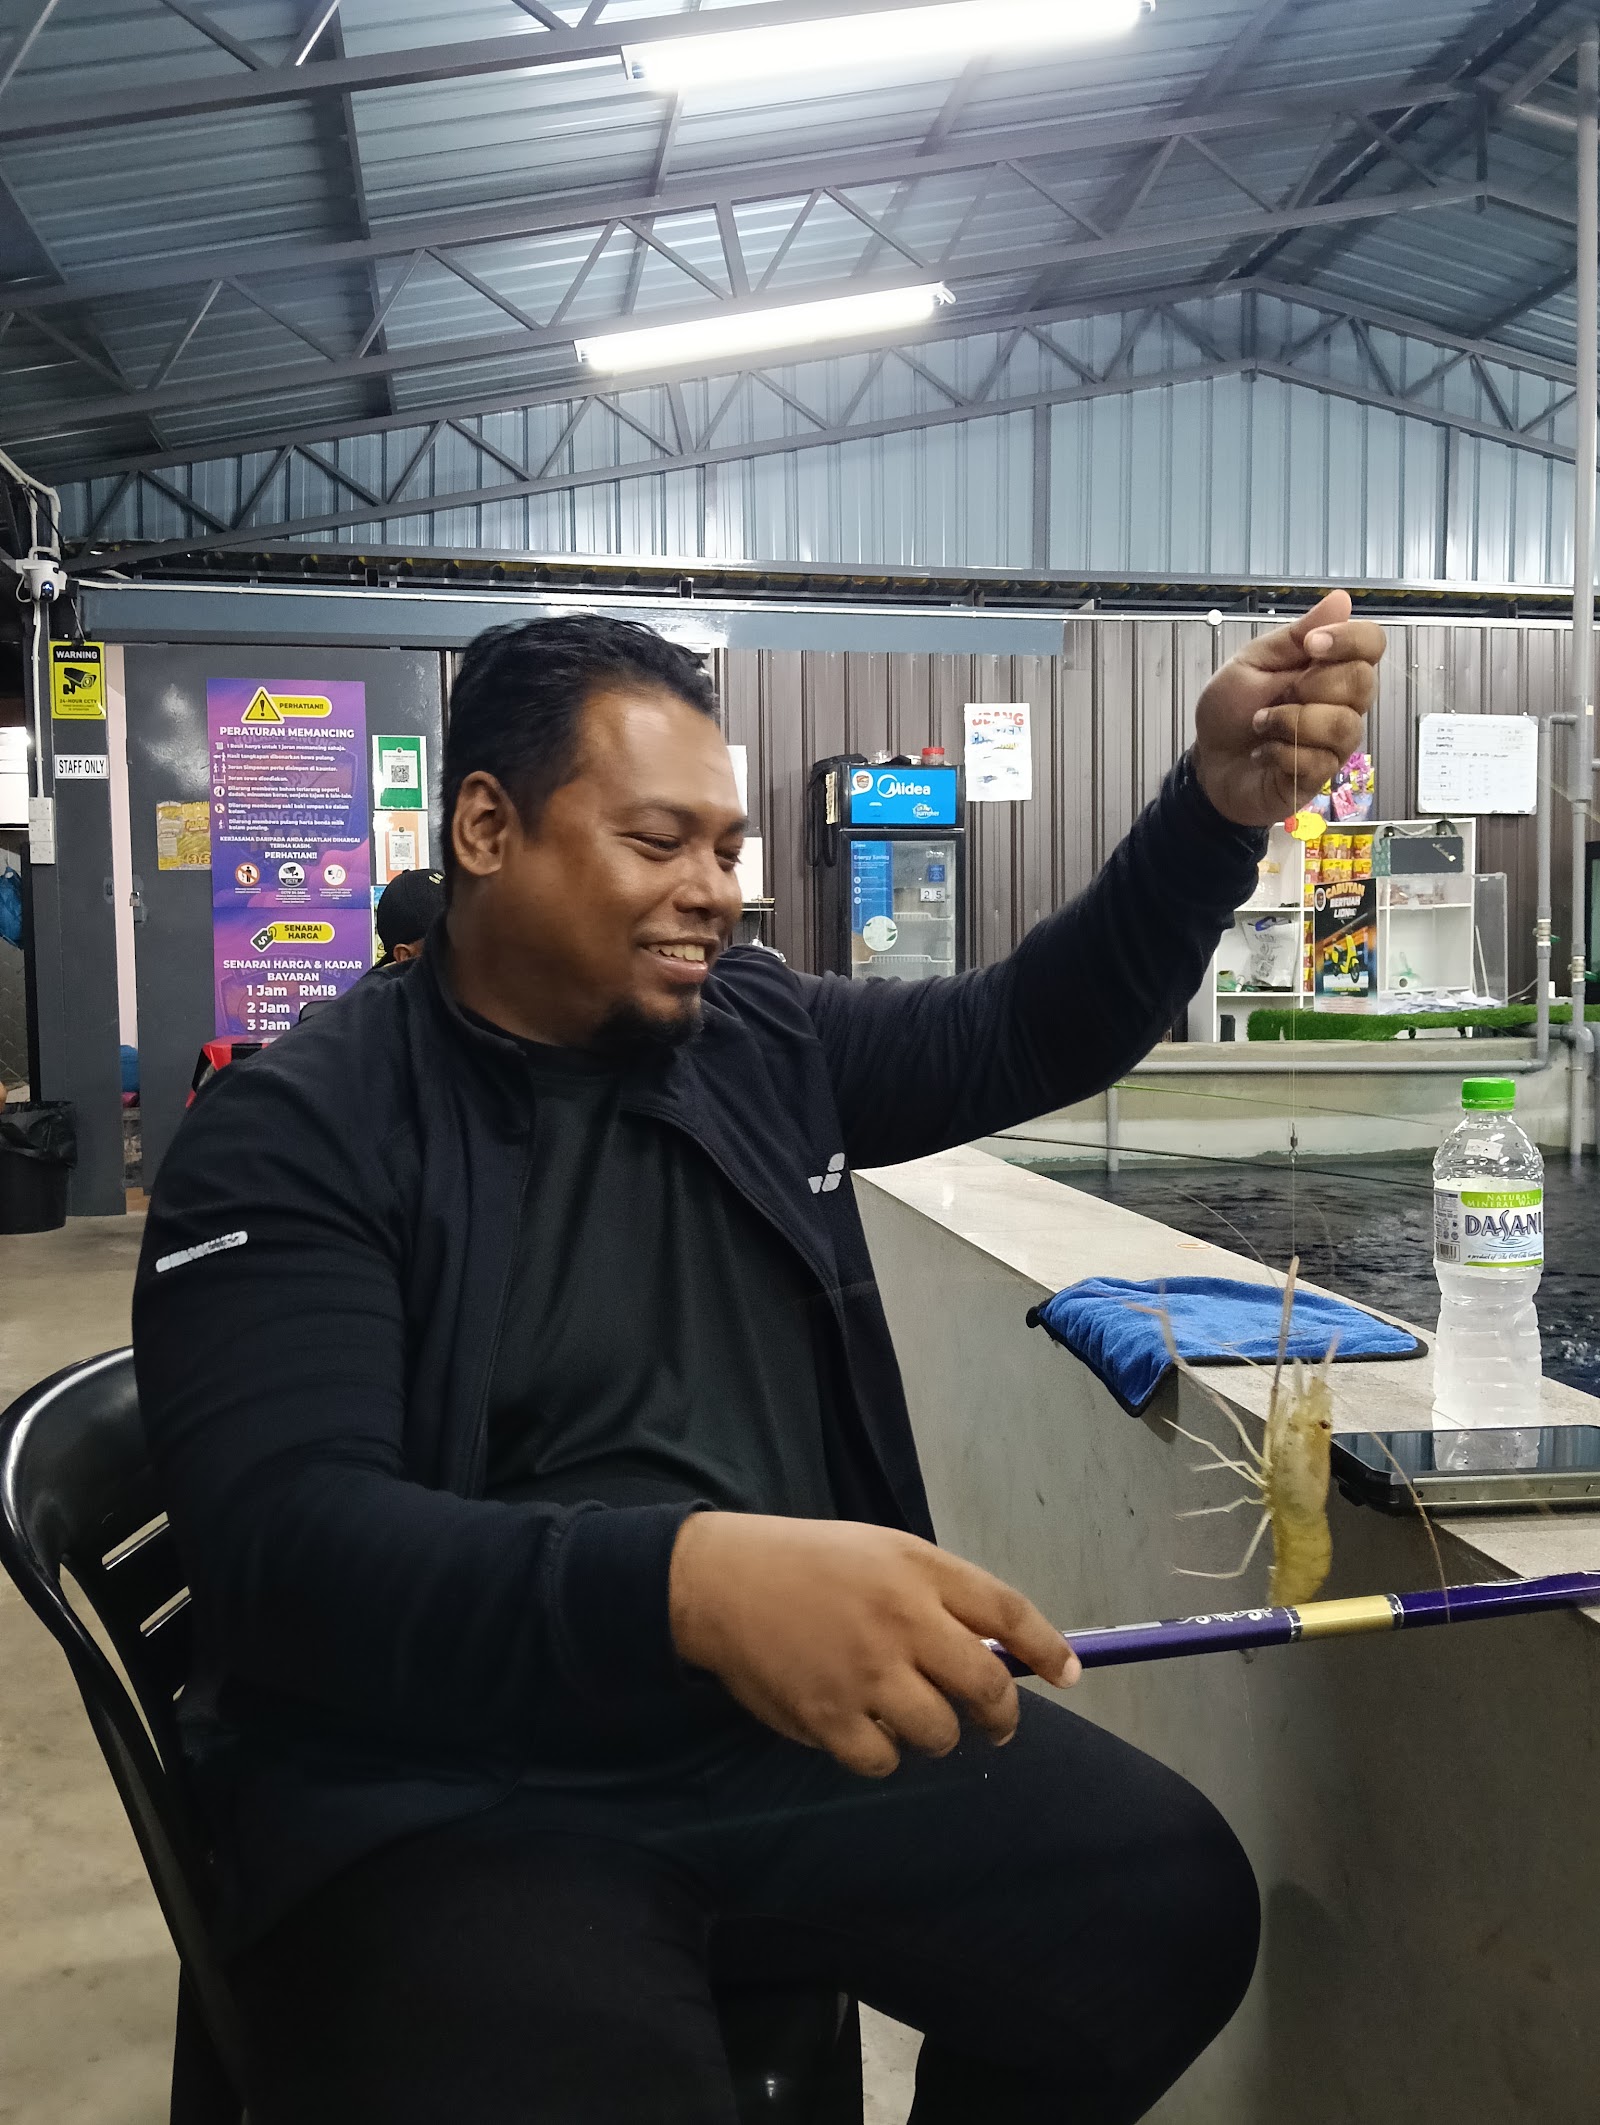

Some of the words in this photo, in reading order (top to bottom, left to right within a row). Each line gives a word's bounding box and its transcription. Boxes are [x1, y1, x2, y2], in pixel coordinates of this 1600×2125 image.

[55, 650, 98, 660] WARNING
[279, 702, 324, 710] PERHATIAN!!
[219, 726, 286, 736] PERATURAN
[288, 727, 355, 739] MEMANCING
[295, 744, 327, 752] memancing
[59, 759, 82, 774] STAFF
[84, 759, 105, 774] ONLY
[880, 779, 931, 796] Midea
[264, 851, 318, 860] PERHATIAN!!
[284, 924, 322, 932] SENARAI
[288, 932, 319, 940] HARGA
[223, 959, 271, 969] SENARAI
[273, 960, 312, 970] HARGA
[313, 961, 323, 969] &
[324, 960, 363, 970] KADAR
[267, 972, 320, 981] BAYARAN
[246, 984, 254, 997] 1
[256, 984, 288, 997] Jam
[299, 984, 337, 997] RM18
[246, 1001, 257, 1014] 2
[258, 1001, 291, 1014] Jam
[246, 1018, 257, 1031] 3
[259, 1018, 291, 1031] Jam
[1486, 1193, 1531, 1201] NATURAL
[1466, 1200, 1515, 1208] MINERAL
[1464, 1209, 1542, 1242] DASANI
